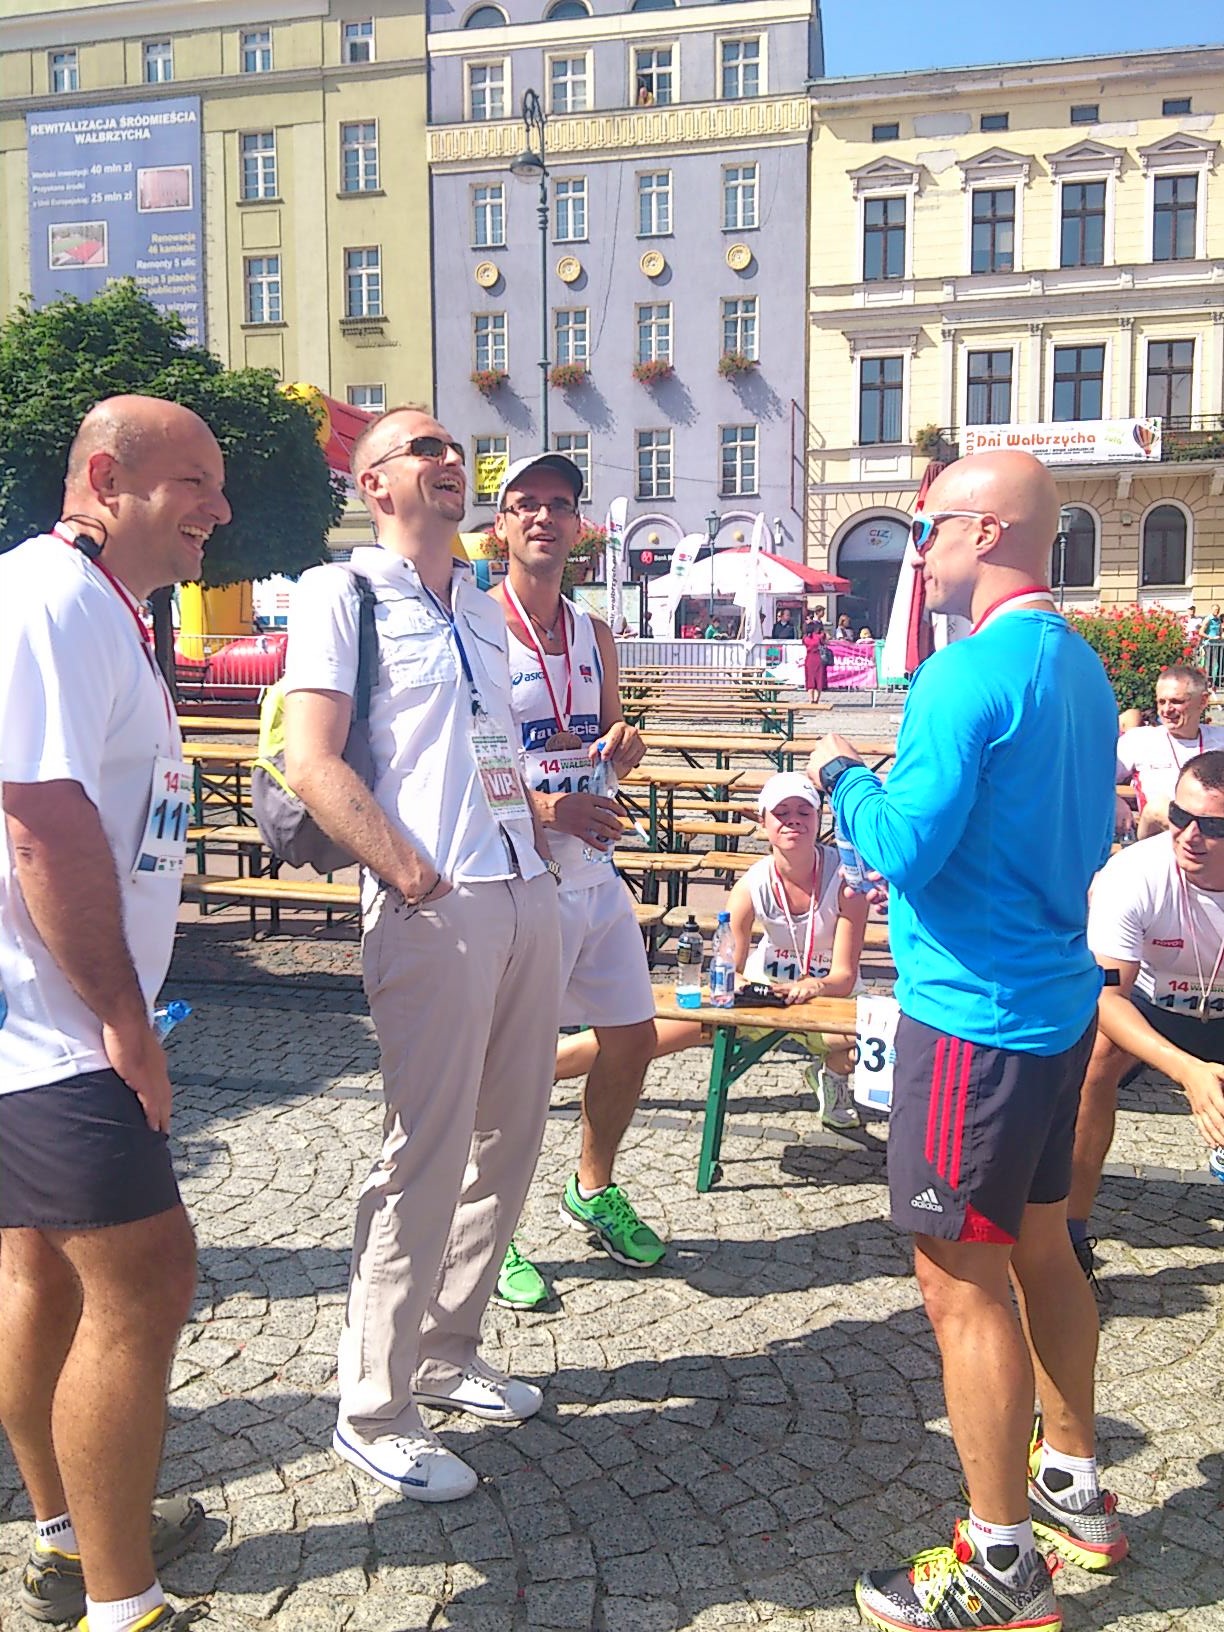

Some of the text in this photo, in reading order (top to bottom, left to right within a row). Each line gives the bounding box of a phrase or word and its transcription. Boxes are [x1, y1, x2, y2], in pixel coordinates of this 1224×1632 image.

[31, 111, 197, 136] REWITALIZACJA ŚRÓDMIEŚCIA
[75, 127, 151, 145] WAŁBRZYCHA
[90, 164, 102, 176] 40
[104, 163, 122, 174] mln
[91, 192, 103, 204] 25
[104, 191, 122, 203] mln
[136, 259, 173, 270] Remonty
[977, 433, 1001, 447] Dni
[540, 760, 560, 774] 14
[164, 771, 180, 793] 14
[488, 772, 513, 796] VIP
[774, 948, 789, 959] 14
[1168, 980, 1190, 992] 14
[911, 1199, 944, 1213] adidas
